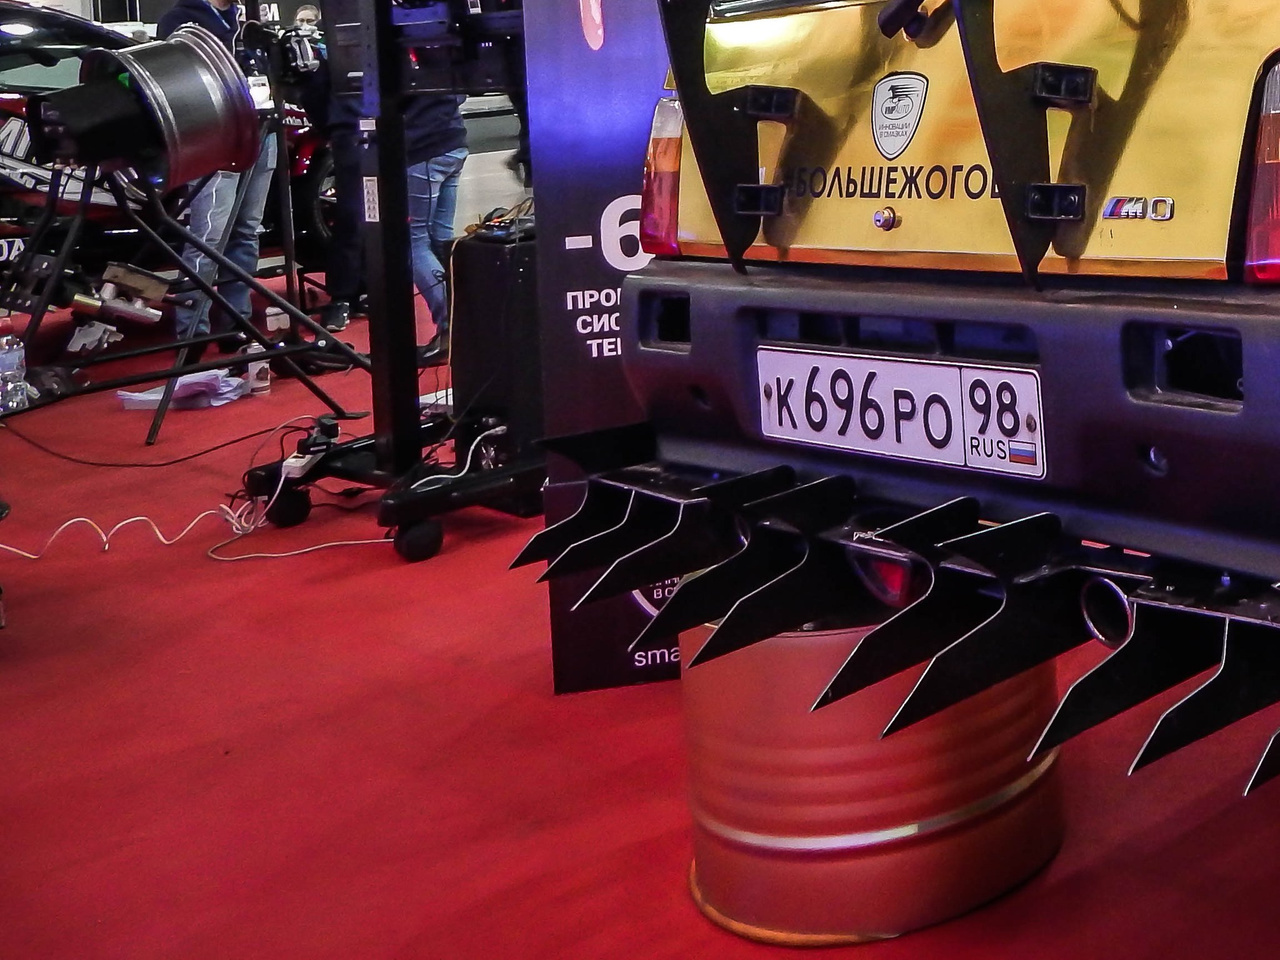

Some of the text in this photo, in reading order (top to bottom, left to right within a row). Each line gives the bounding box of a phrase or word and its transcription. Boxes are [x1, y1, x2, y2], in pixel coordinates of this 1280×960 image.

[566, 288, 622, 310] ПРО
[586, 337, 622, 358] ТЕ
[968, 378, 1020, 437] 98
[970, 436, 1007, 460] RUS
